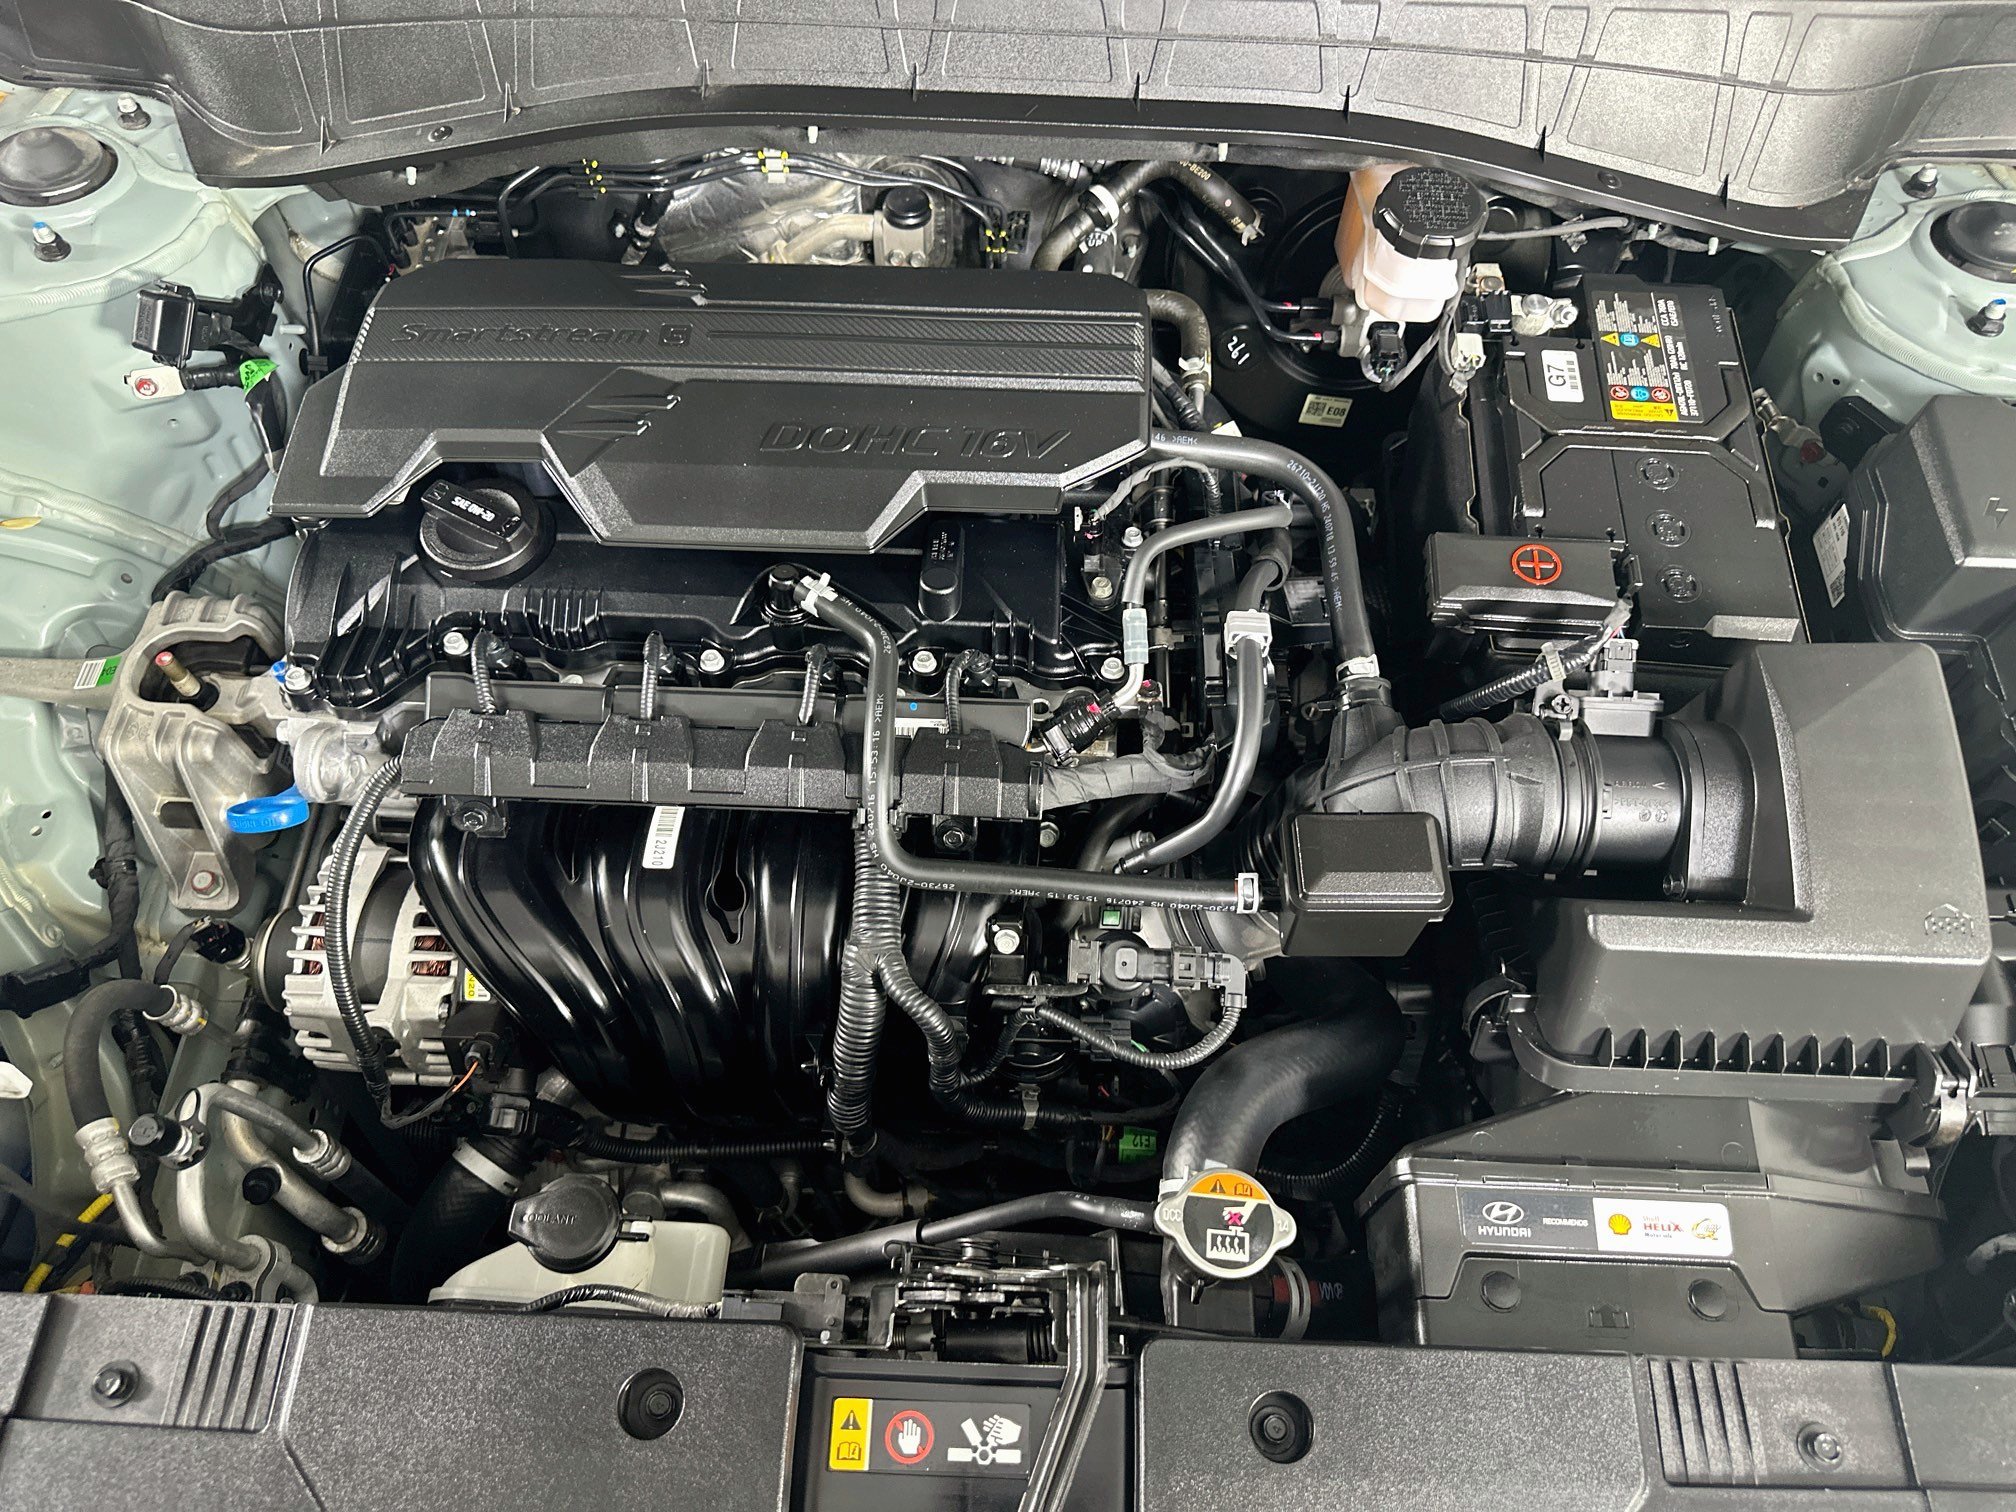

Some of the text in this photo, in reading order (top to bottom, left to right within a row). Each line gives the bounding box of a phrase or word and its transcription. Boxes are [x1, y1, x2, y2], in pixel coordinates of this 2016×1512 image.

[1660, 313, 1670, 327] CCA
[392, 322, 650, 344] Smartstream
[1228, 335, 1250, 366] 261
[1547, 364, 1567, 387] G7
[1326, 406, 1347, 417] E08
[760, 422, 1071, 459] DOHC 16V
[451, 495, 496, 522] SAE 0W-20
[868, 729, 881, 786] 15:53:16
[866, 791, 876, 837] 240716
[651, 839, 668, 867] 2J210
[868, 841, 881, 859] HS
[879, 862, 956, 891] 26730-2J040
[1149, 900, 1165, 909] HS
[1168, 901, 1236, 912] 6730-2J040
[1478, 1217, 1589, 1238] HYUNDAI RECOMMENDS
[1643, 1221, 1683, 1233] HELIX
